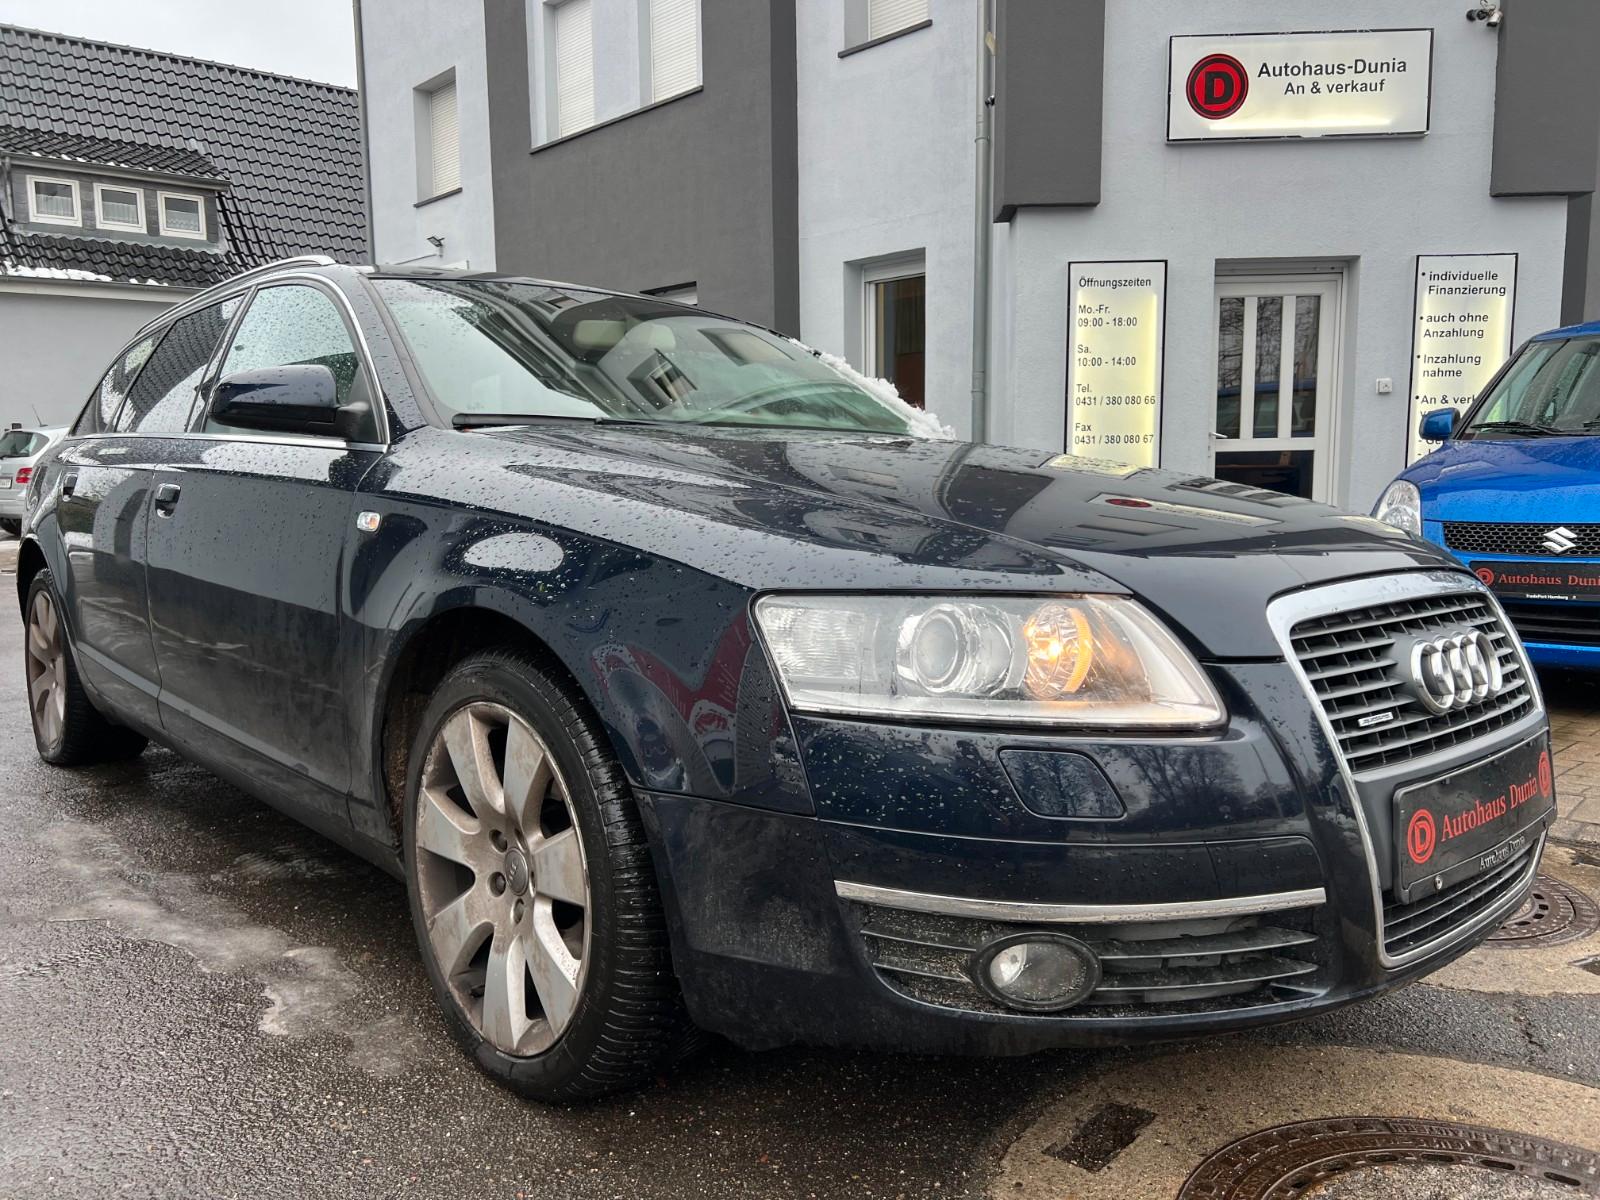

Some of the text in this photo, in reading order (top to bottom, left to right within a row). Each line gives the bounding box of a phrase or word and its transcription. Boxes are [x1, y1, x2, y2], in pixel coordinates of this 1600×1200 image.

[1257, 57, 1407, 78] Autohaus-Dunia
[1204, 71, 1234, 105] D
[1284, 79, 1385, 95] An & verkauf
[1429, 271, 1499, 281] individuelle
[1079, 276, 1151, 289] Öffnungszeiten
[1428, 285, 1506, 297] Finanzierung
[1078, 305, 1110, 314] Mo.-Fr.
[1078, 318, 1103, 327] 09:00
[1112, 317, 1138, 326] 18:00
[1426, 313, 1489, 323] auch ohne
[1424, 328, 1484, 339] Anzahlung
[1077, 345, 1092, 354] Sa.
[1078, 358, 1102, 367] 10:00
[1111, 357, 1137, 366] 14:00
[1424, 354, 1481, 366] Inzahlung
[1423, 367, 1462, 378] nahme
[1076, 384, 1092, 393] Tel.
[1076, 397, 1097, 405] 0431
[1105, 396, 1121, 405] 380
[1125, 396, 1141, 405] 080
[1144, 396, 1156, 405] 66
[1421, 395, 1437, 405] An
[1440, 395, 1449, 404] &
[1075, 423, 1092, 432] Fax
[1075, 436, 1096, 445] 0431
[1104, 435, 1121, 444] 380
[1124, 435, 1140, 444] 080
[1143, 435, 1154, 443] 67
[1499, 573, 1562, 585] Autohaus
[1441, 773, 1538, 842] Autohaus Dunia
[1414, 821, 1431, 853] D
